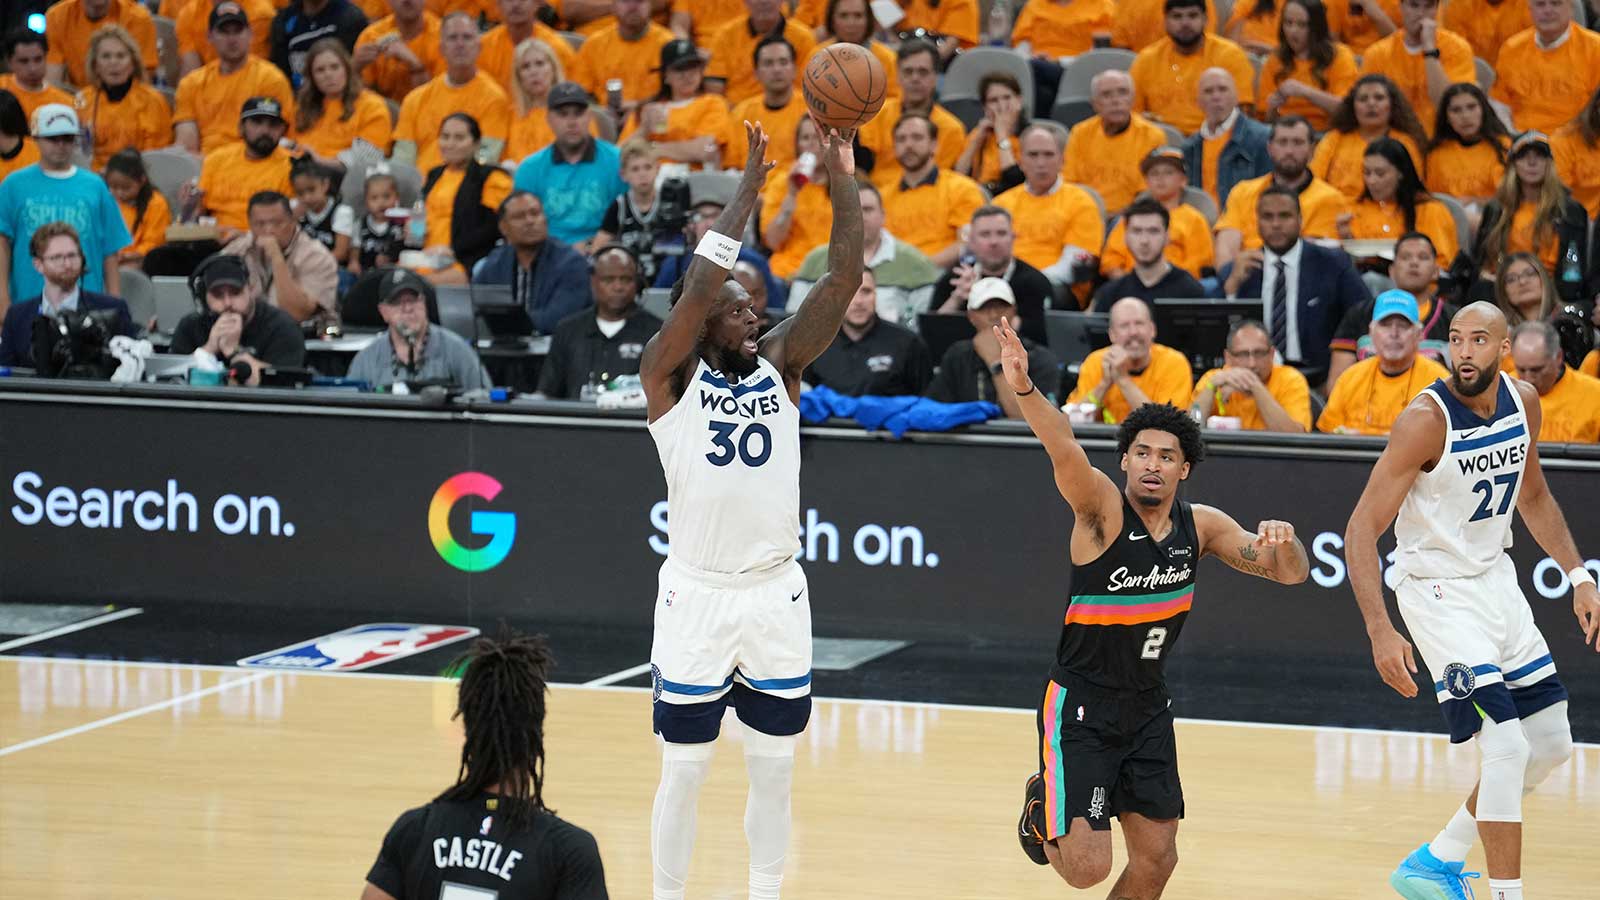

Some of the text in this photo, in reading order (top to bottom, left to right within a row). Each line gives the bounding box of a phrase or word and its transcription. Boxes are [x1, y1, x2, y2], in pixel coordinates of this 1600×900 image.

[27, 204, 88, 232] SPURS
[705, 420, 772, 467] 30
[1458, 443, 1525, 476] WOLVES
[11, 471, 296, 537] Search on.
[1468, 471, 1519, 522] 27
[428, 471, 516, 572] G
[853, 523, 939, 568] on.
[1107, 566, 1143, 592] San
[1142, 563, 1192, 590] Antonio
[1140, 626, 1168, 660] 2
[433, 836, 524, 881] CASTLE
